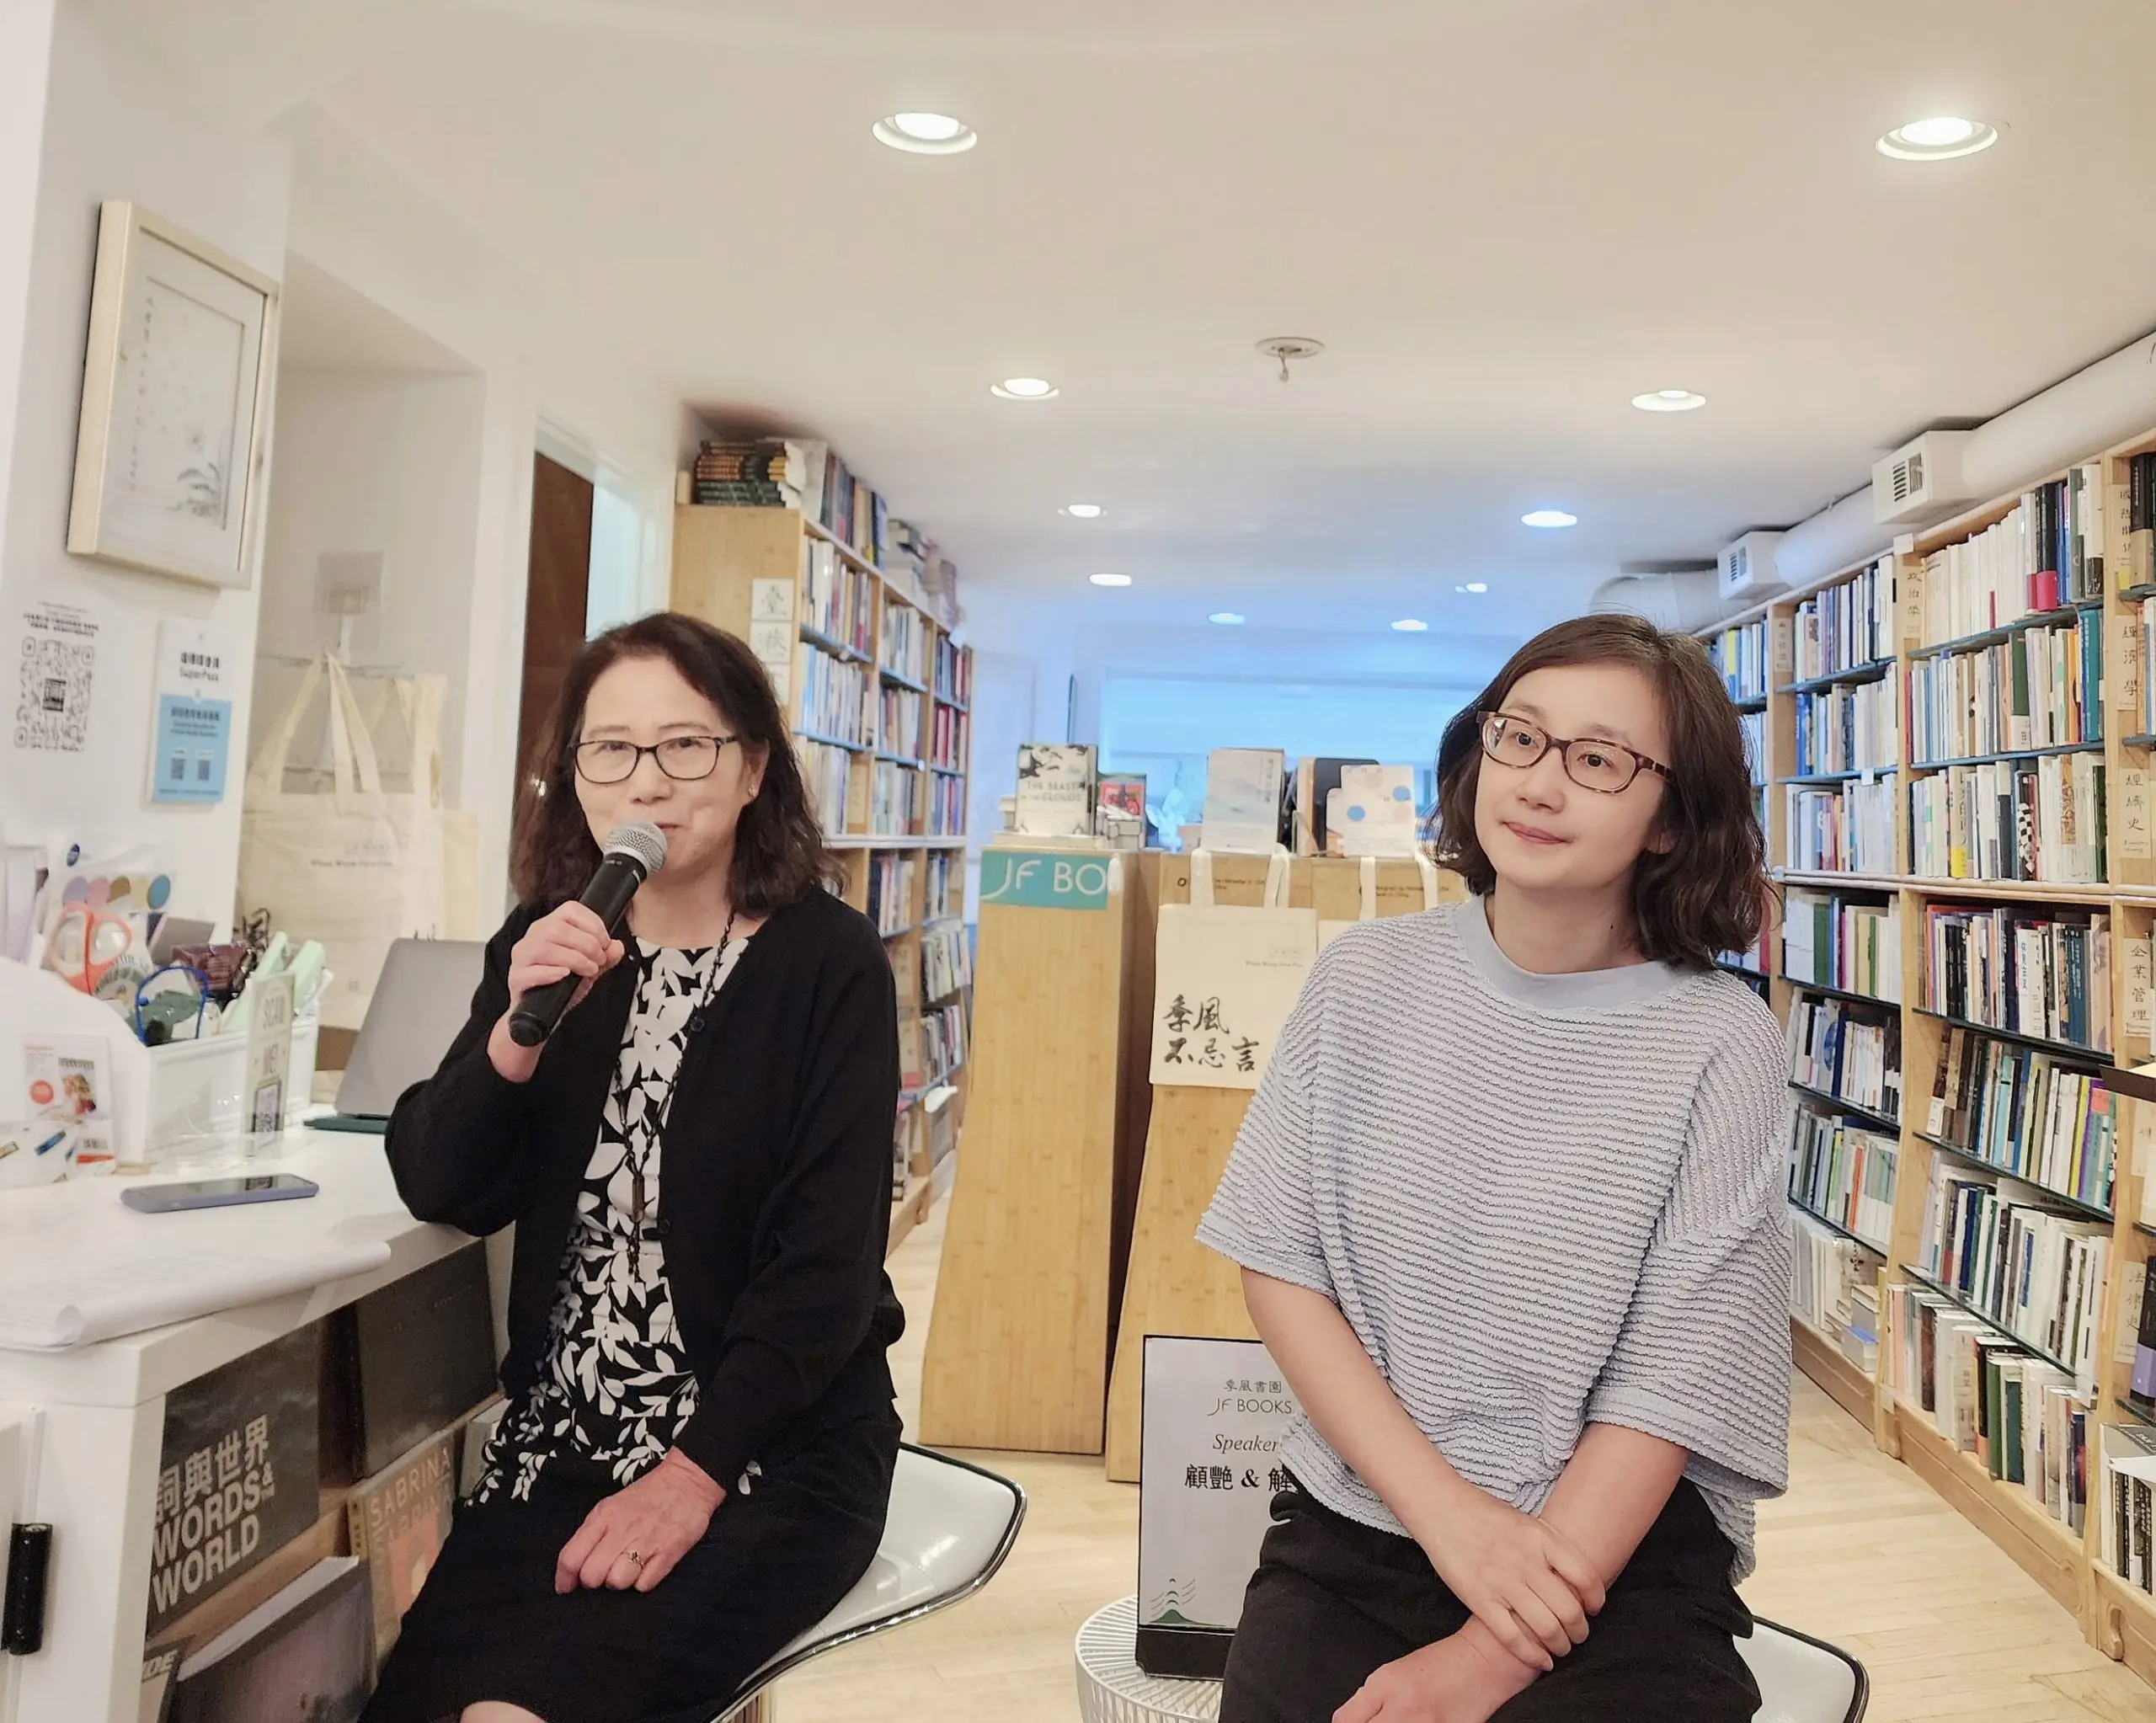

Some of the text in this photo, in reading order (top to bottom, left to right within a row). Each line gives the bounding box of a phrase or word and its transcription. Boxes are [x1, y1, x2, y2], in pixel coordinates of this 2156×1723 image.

[980, 857, 1042, 899] JF
[2131, 945, 2149, 1021] 企業管理
[1162, 994, 1230, 1034] 季風
[1164, 1037, 1260, 1072] 不忌言
[1224, 1379, 1282, 1393] 季風書園
[1207, 1398, 1292, 1416] JF BOOKS
[371, 1446, 451, 1528] SABRINA
[1241, 1469, 1261, 1488] &
[153, 1470, 260, 1567] WORDS
[152, 1514, 260, 1614] WORLD
